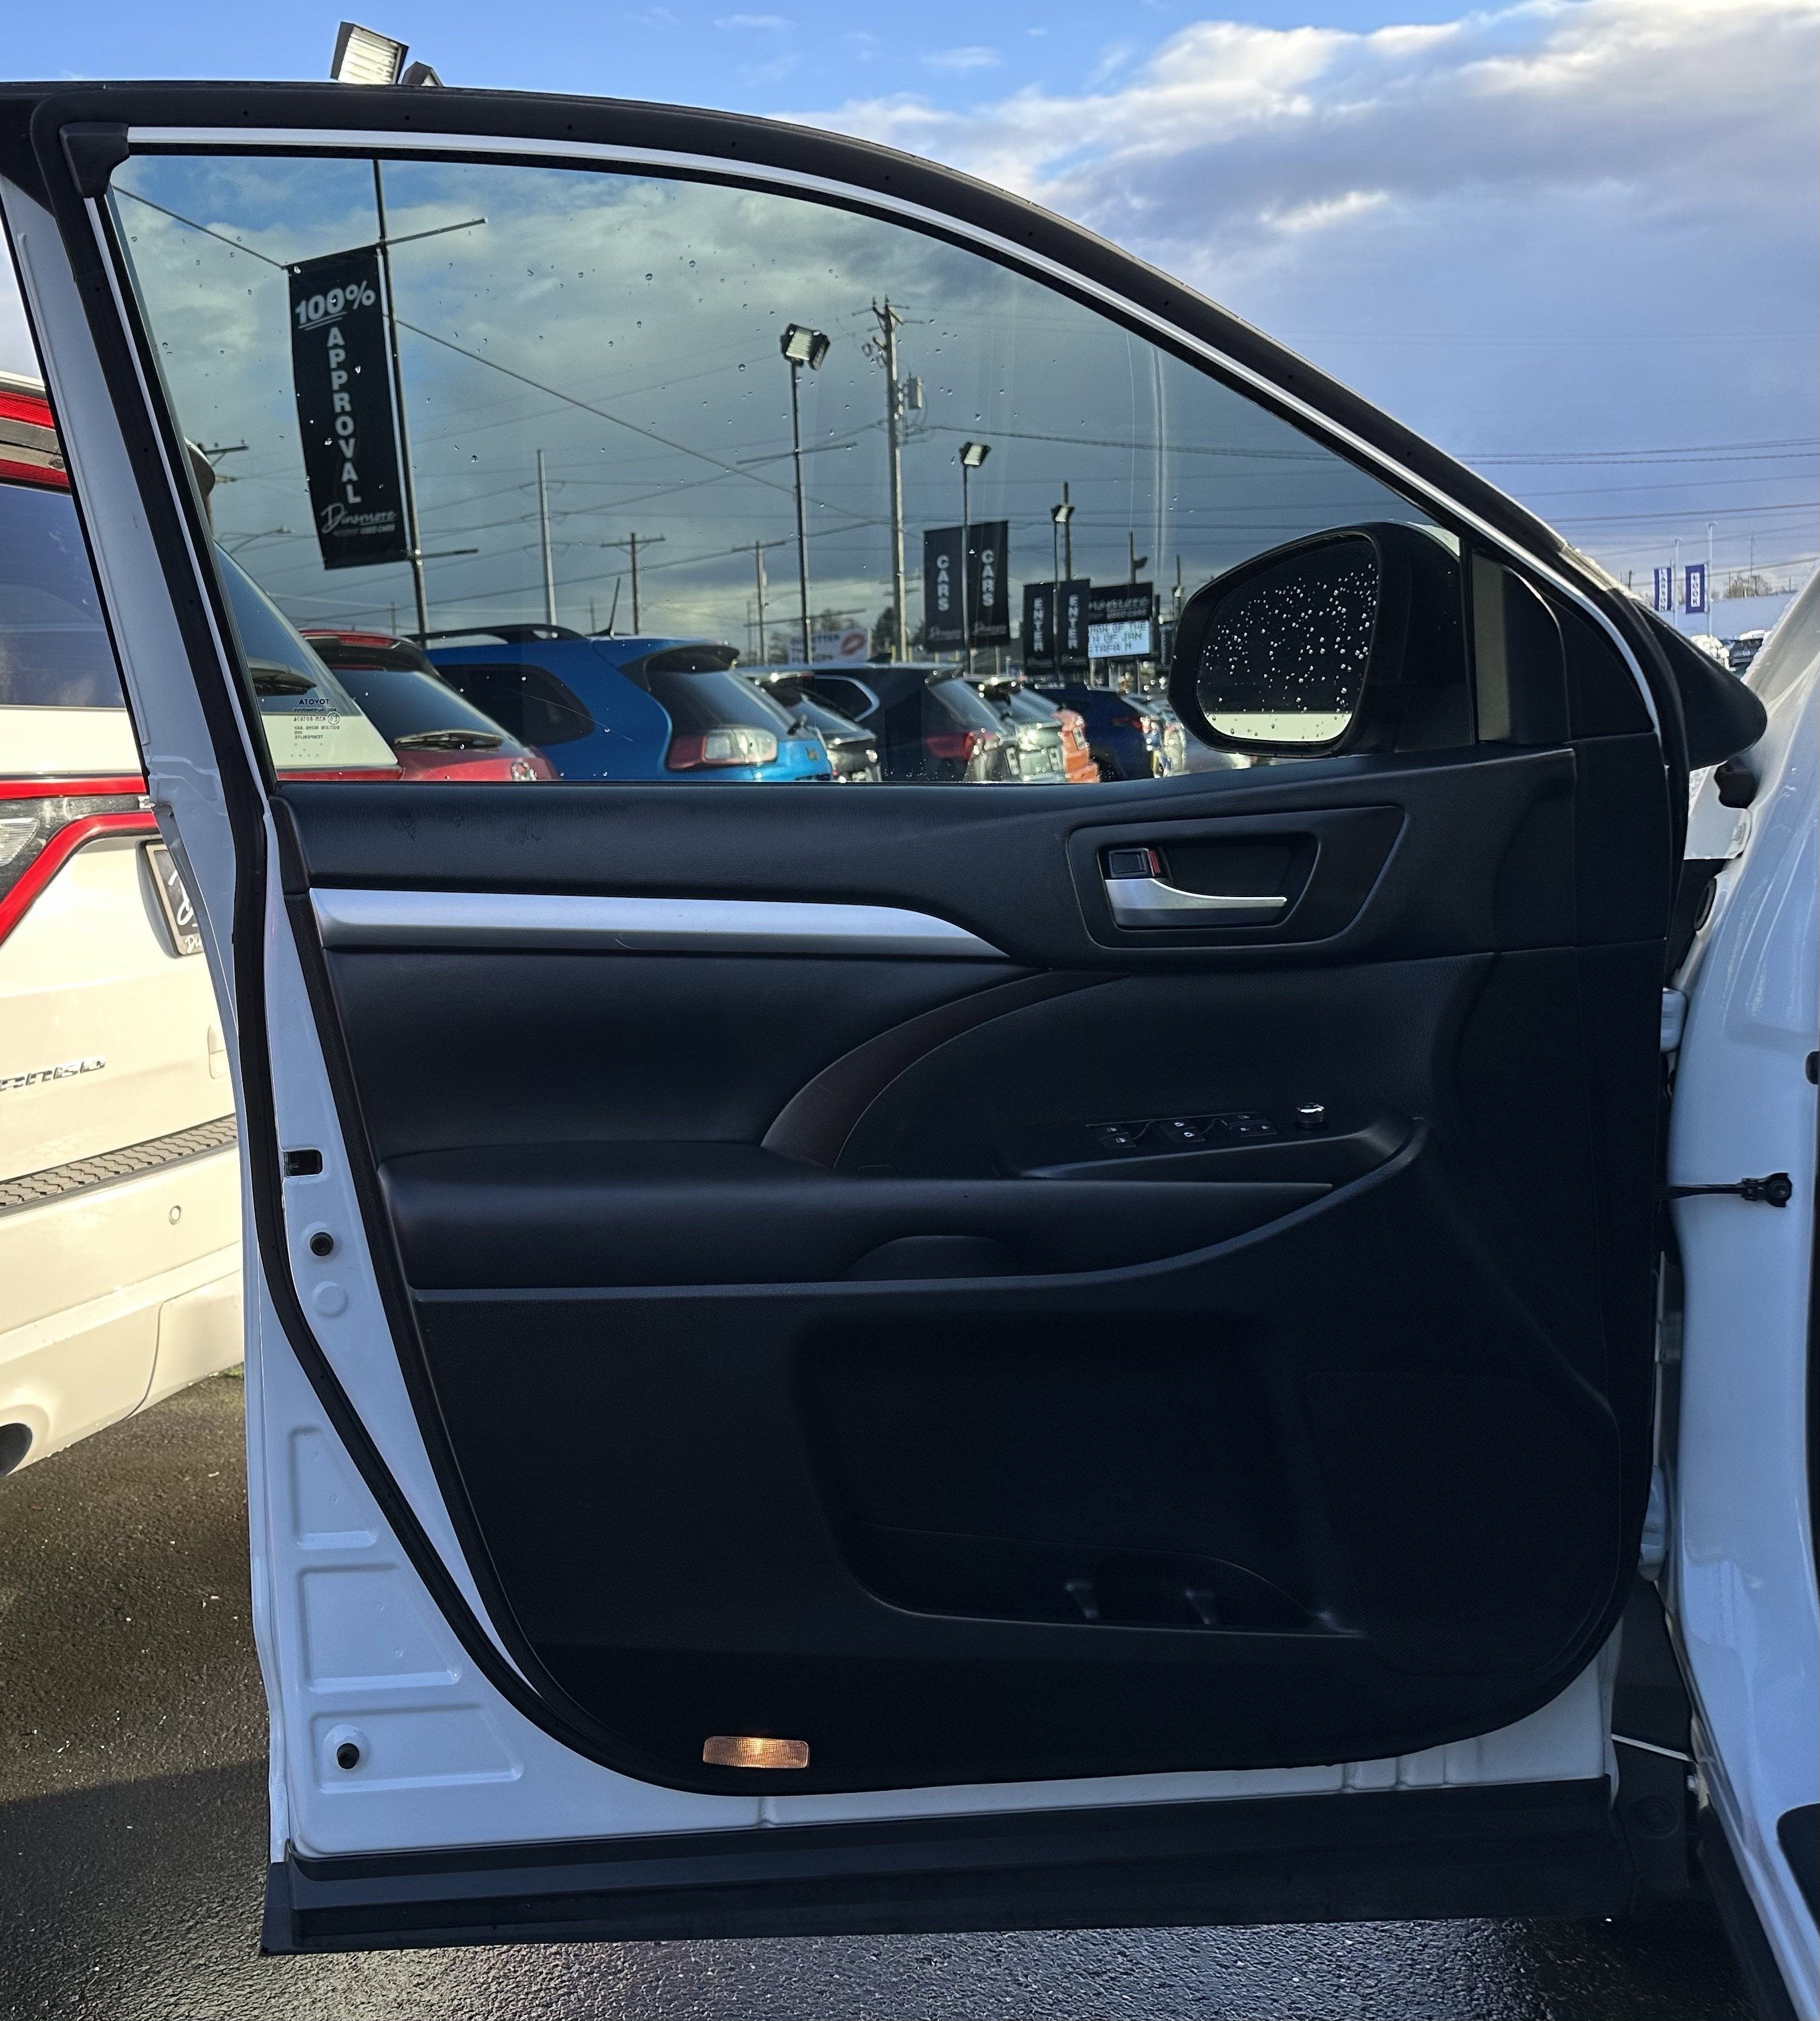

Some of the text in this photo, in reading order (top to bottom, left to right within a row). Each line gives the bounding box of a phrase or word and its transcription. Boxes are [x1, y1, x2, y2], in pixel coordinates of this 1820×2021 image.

[295, 281, 376, 324] 100%
[326, 327, 362, 504] APPROVAL
[936, 554, 950, 611] CARS
[981, 549, 995, 607] CARS
[1033, 597, 1045, 652] ENTER
[1068, 595, 1079, 650] ENTER
